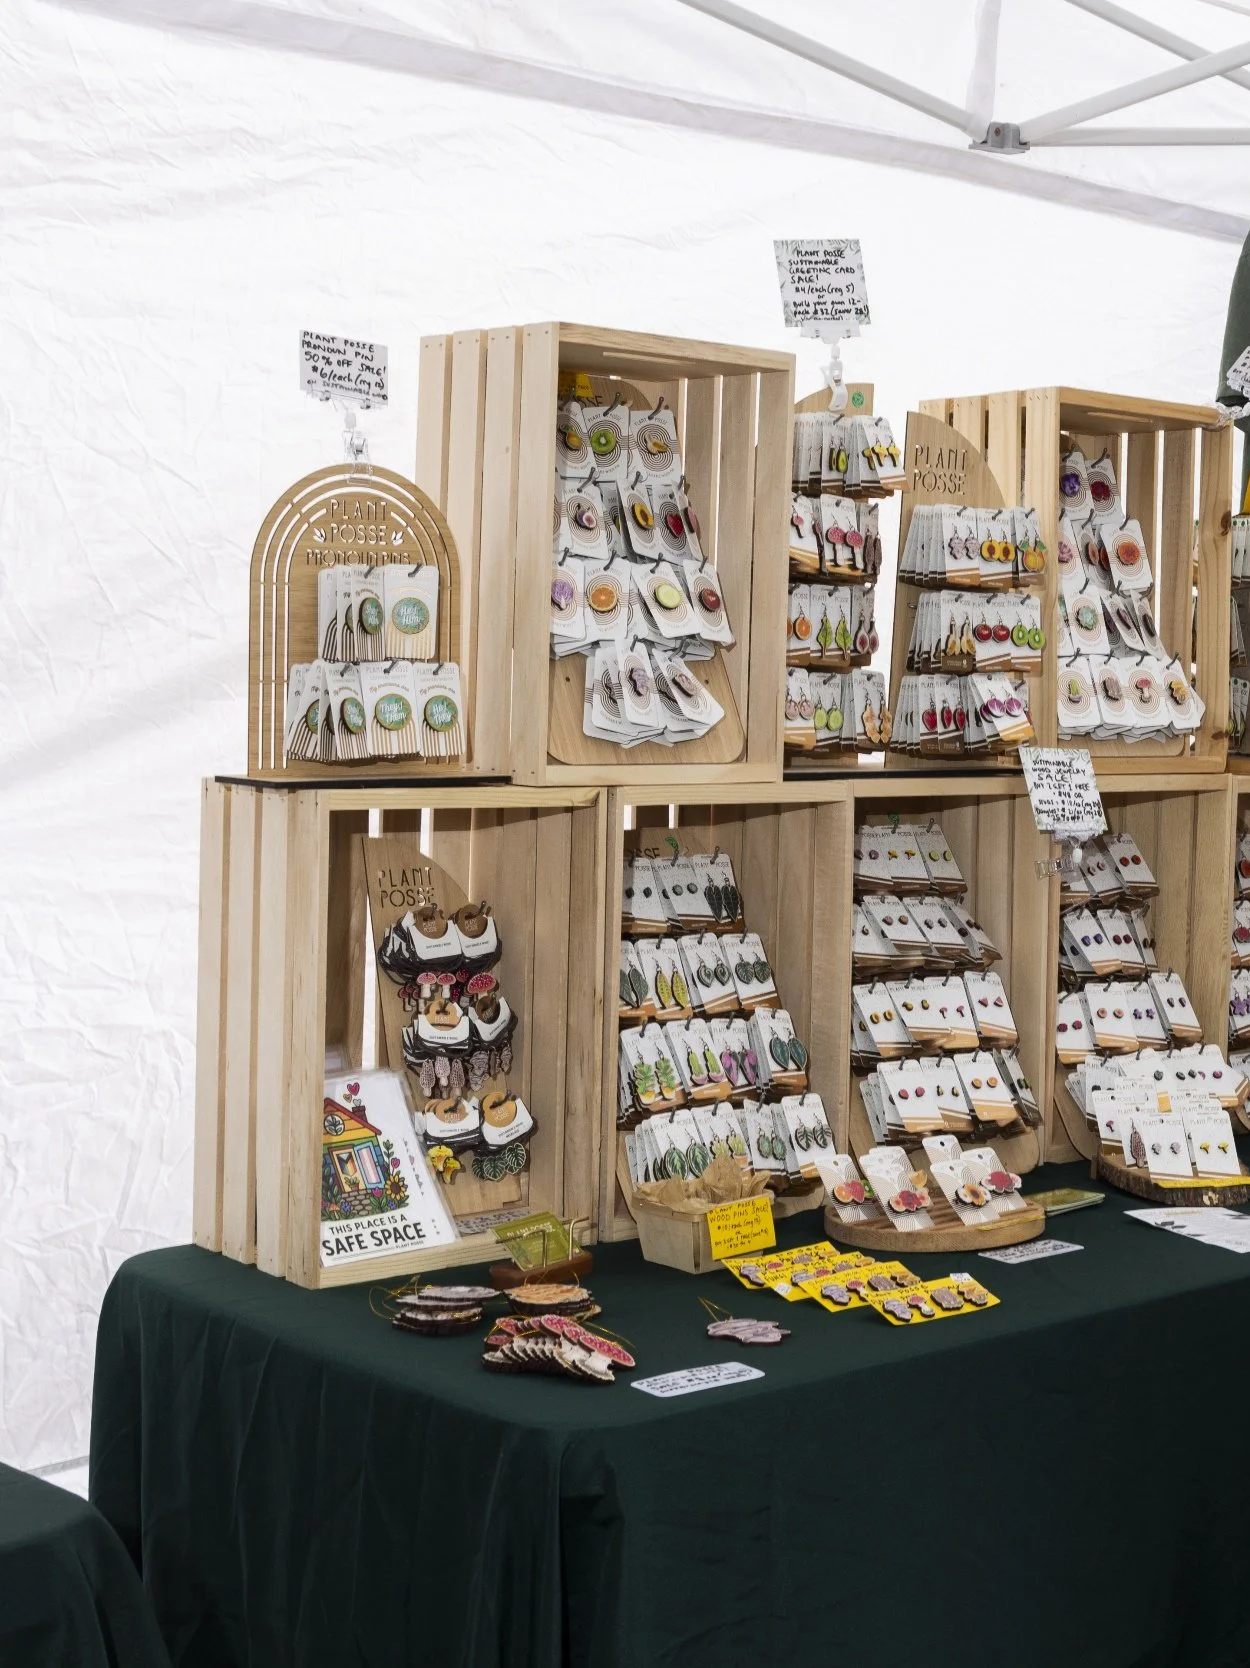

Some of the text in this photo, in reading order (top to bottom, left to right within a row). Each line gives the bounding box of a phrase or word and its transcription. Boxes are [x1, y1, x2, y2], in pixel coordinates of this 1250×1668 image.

[796, 250, 845, 258] PLANT POSSE
[789, 267, 831, 275] GREETING
[302, 340, 374, 362] PRONOUN PIN
[304, 331, 374, 352] PLANT POSSE
[336, 359, 352, 368] OFF
[914, 444, 968, 470] PLANT
[913, 469, 966, 496] POSSE
[331, 499, 387, 521] PLANT
[331, 523, 387, 545] POSSE
[306, 549, 378, 566] PRONOUN
[1038, 773, 1072, 782] SALE!
[378, 867, 432, 888] PLANT
[380, 888, 434, 908] POSSE
[329, 1213, 408, 1236] THIS PLACE IS A
[710, 1214, 730, 1223] WOOD
[734, 1209, 748, 1219] PINS
[322, 1222, 426, 1257] SAFE SPACE
